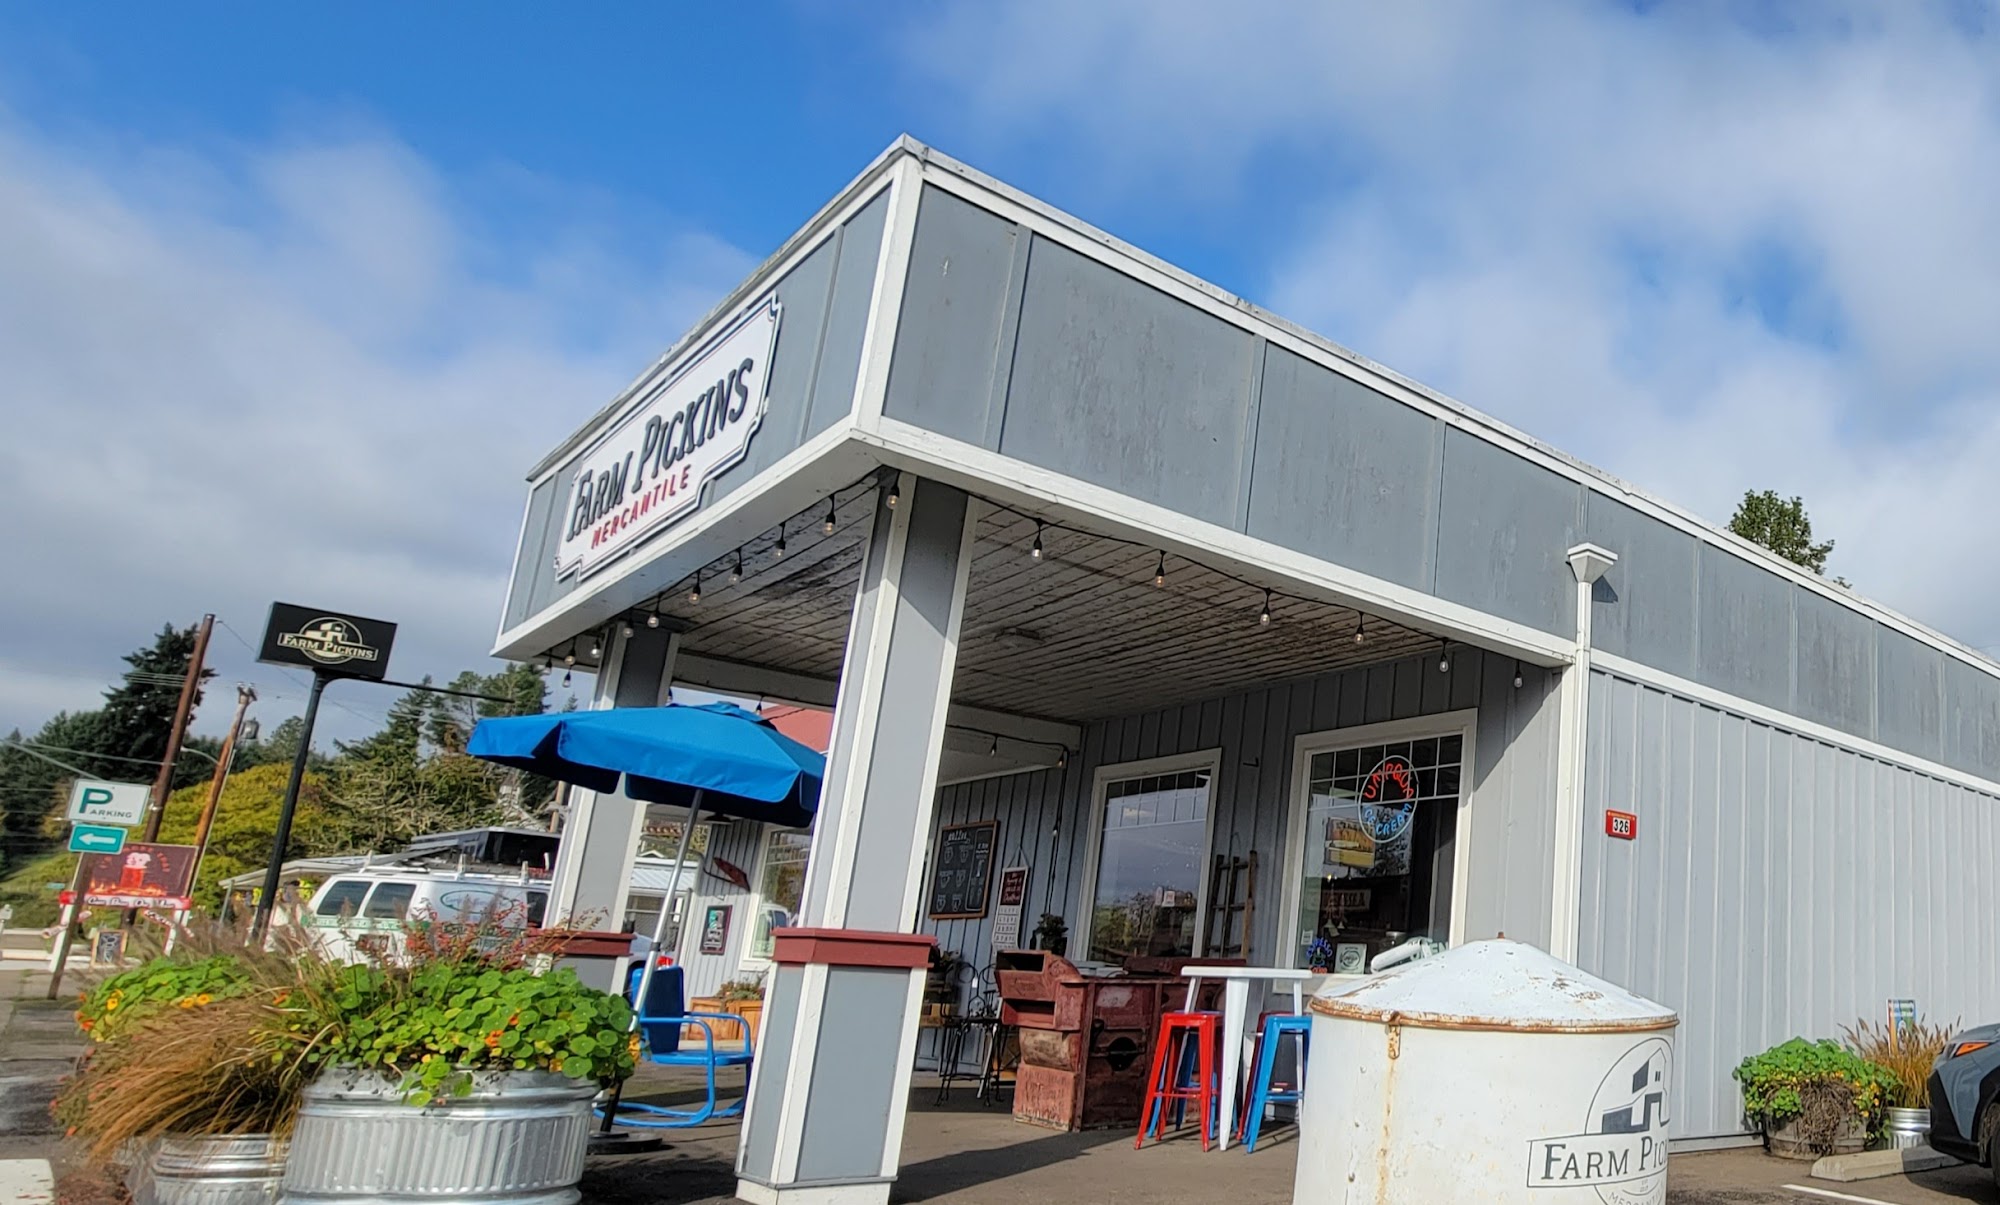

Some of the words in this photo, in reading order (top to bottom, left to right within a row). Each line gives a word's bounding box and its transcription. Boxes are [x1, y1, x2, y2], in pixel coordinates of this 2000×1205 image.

[566, 450, 634, 542] FARM
[631, 357, 754, 494] PICKINS
[591, 464, 691, 549] MERCANTILE
[283, 634, 318, 650] FARM
[322, 641, 374, 659] PICKINS
[79, 787, 132, 818] PARKING
[1376, 803, 1412, 836] CREAM
[1614, 819, 1629, 833] 326
[1541, 1143, 1630, 1180] FARM
